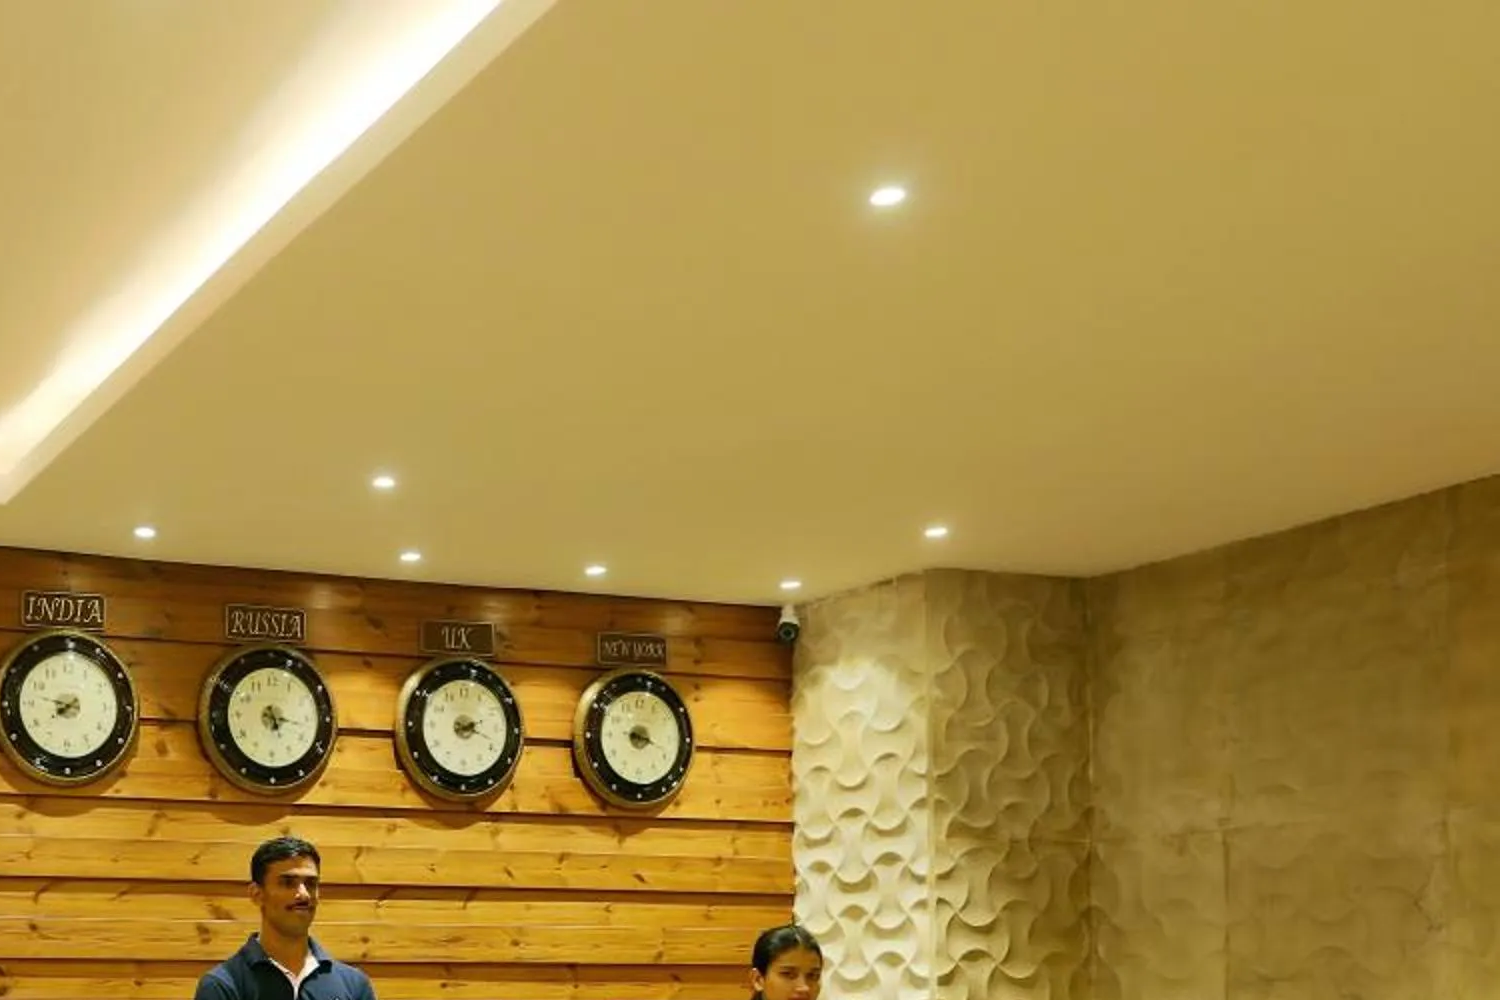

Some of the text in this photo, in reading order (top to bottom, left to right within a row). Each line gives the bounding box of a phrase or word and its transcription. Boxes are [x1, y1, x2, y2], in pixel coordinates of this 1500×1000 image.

[26, 596, 103, 623] INDIA
[231, 609, 302, 639] RUSSIA
[441, 625, 472, 650] UK
